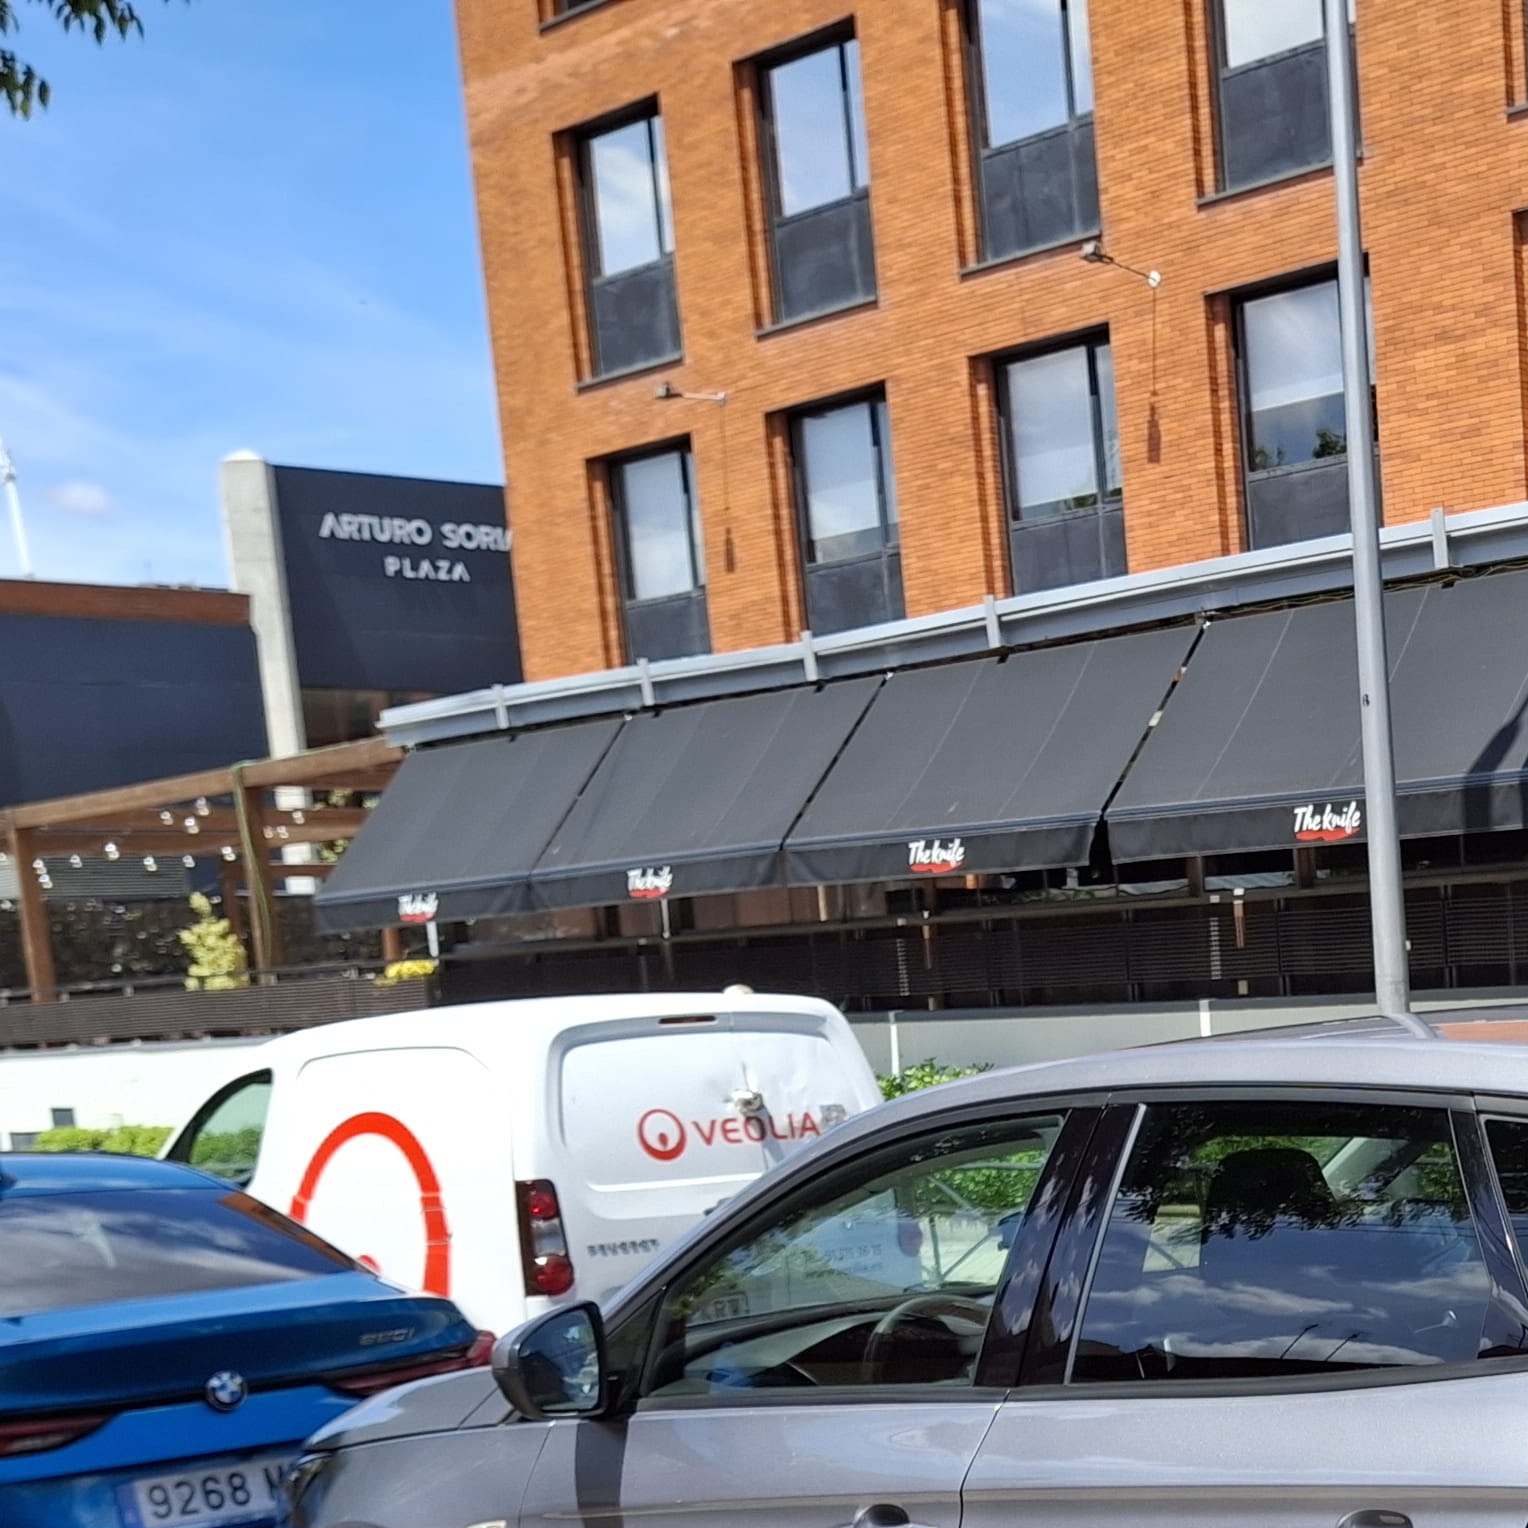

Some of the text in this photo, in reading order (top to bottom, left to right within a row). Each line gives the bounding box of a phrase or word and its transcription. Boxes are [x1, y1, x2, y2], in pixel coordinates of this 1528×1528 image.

[318, 511, 432, 546] ARTURO
[384, 555, 471, 582] PLAZA
[1293, 800, 1361, 835] The knife
[908, 839, 931, 866] The
[692, 1111, 821, 1147] VEOLIA
[148, 1471, 250, 1520] 9268
